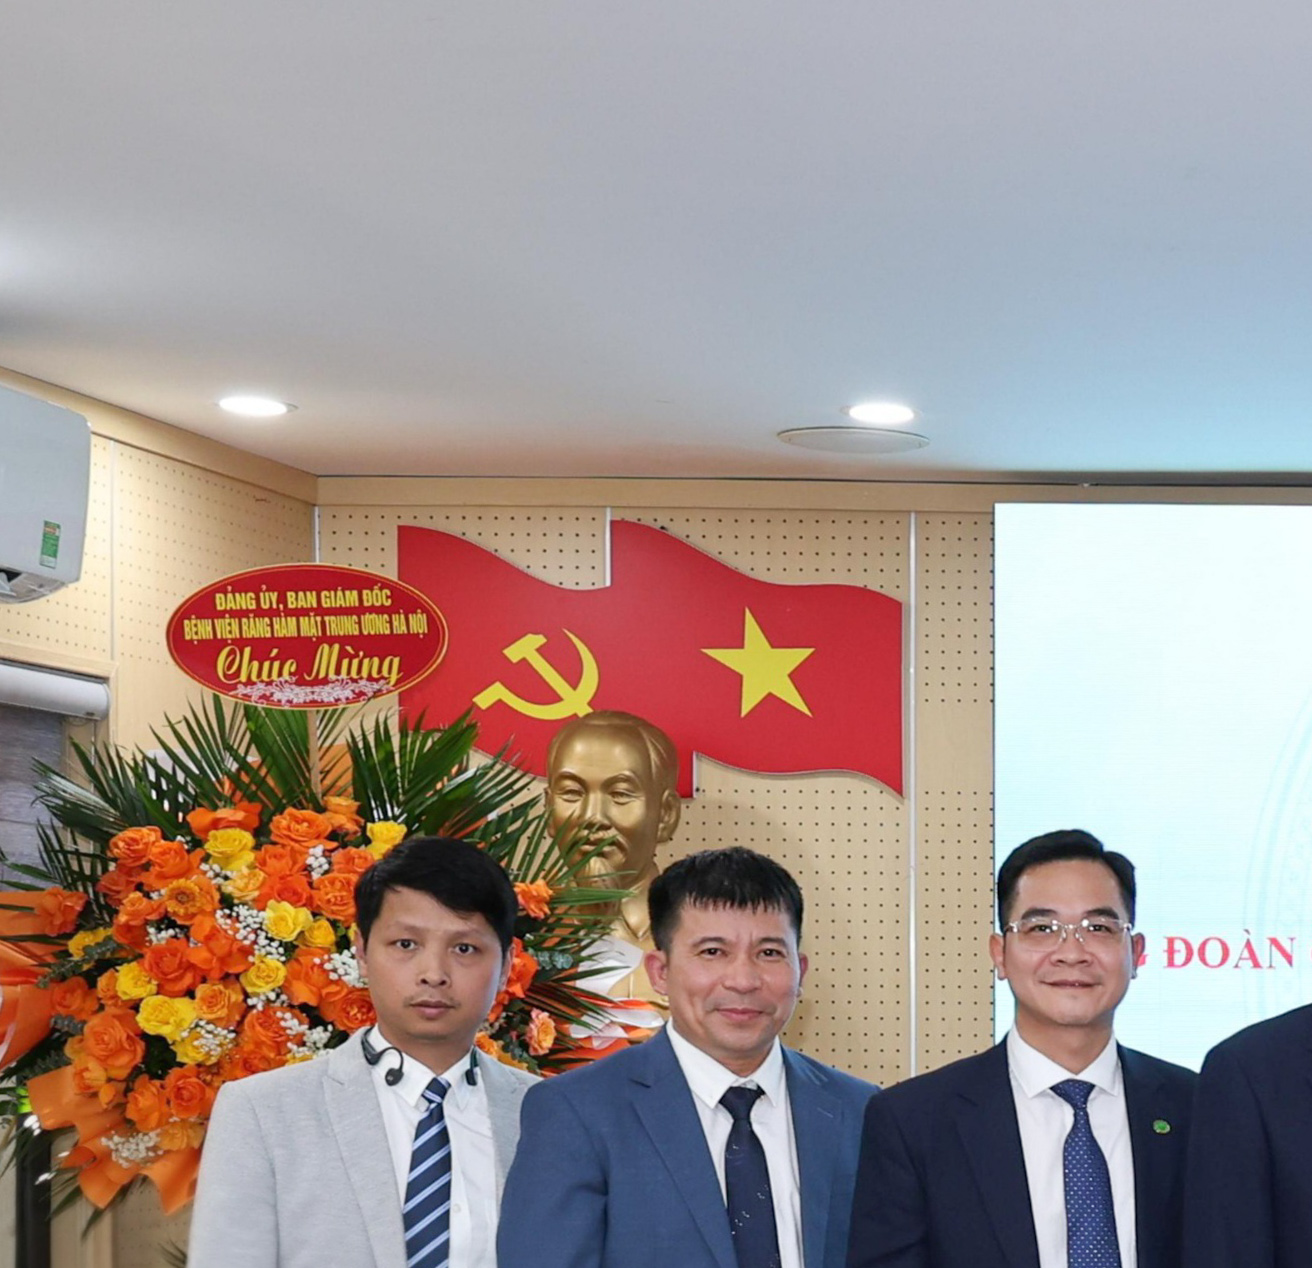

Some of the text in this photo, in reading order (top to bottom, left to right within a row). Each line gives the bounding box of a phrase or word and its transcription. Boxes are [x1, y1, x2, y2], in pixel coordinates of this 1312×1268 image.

[215, 585, 256, 611] ĐẢNG
[287, 591, 317, 609] BAN
[320, 587, 359, 608] GIÁM
[363, 583, 392, 607] ĐỐC
[183, 609, 428, 645] BỆNH VIỆN RĂNG HÀM MẶT TRUNG ƯƠNG HÀ NỘI
[216, 643, 403, 685] Chúc Mừng
[1163, 929, 1296, 969] ĐOÀN
